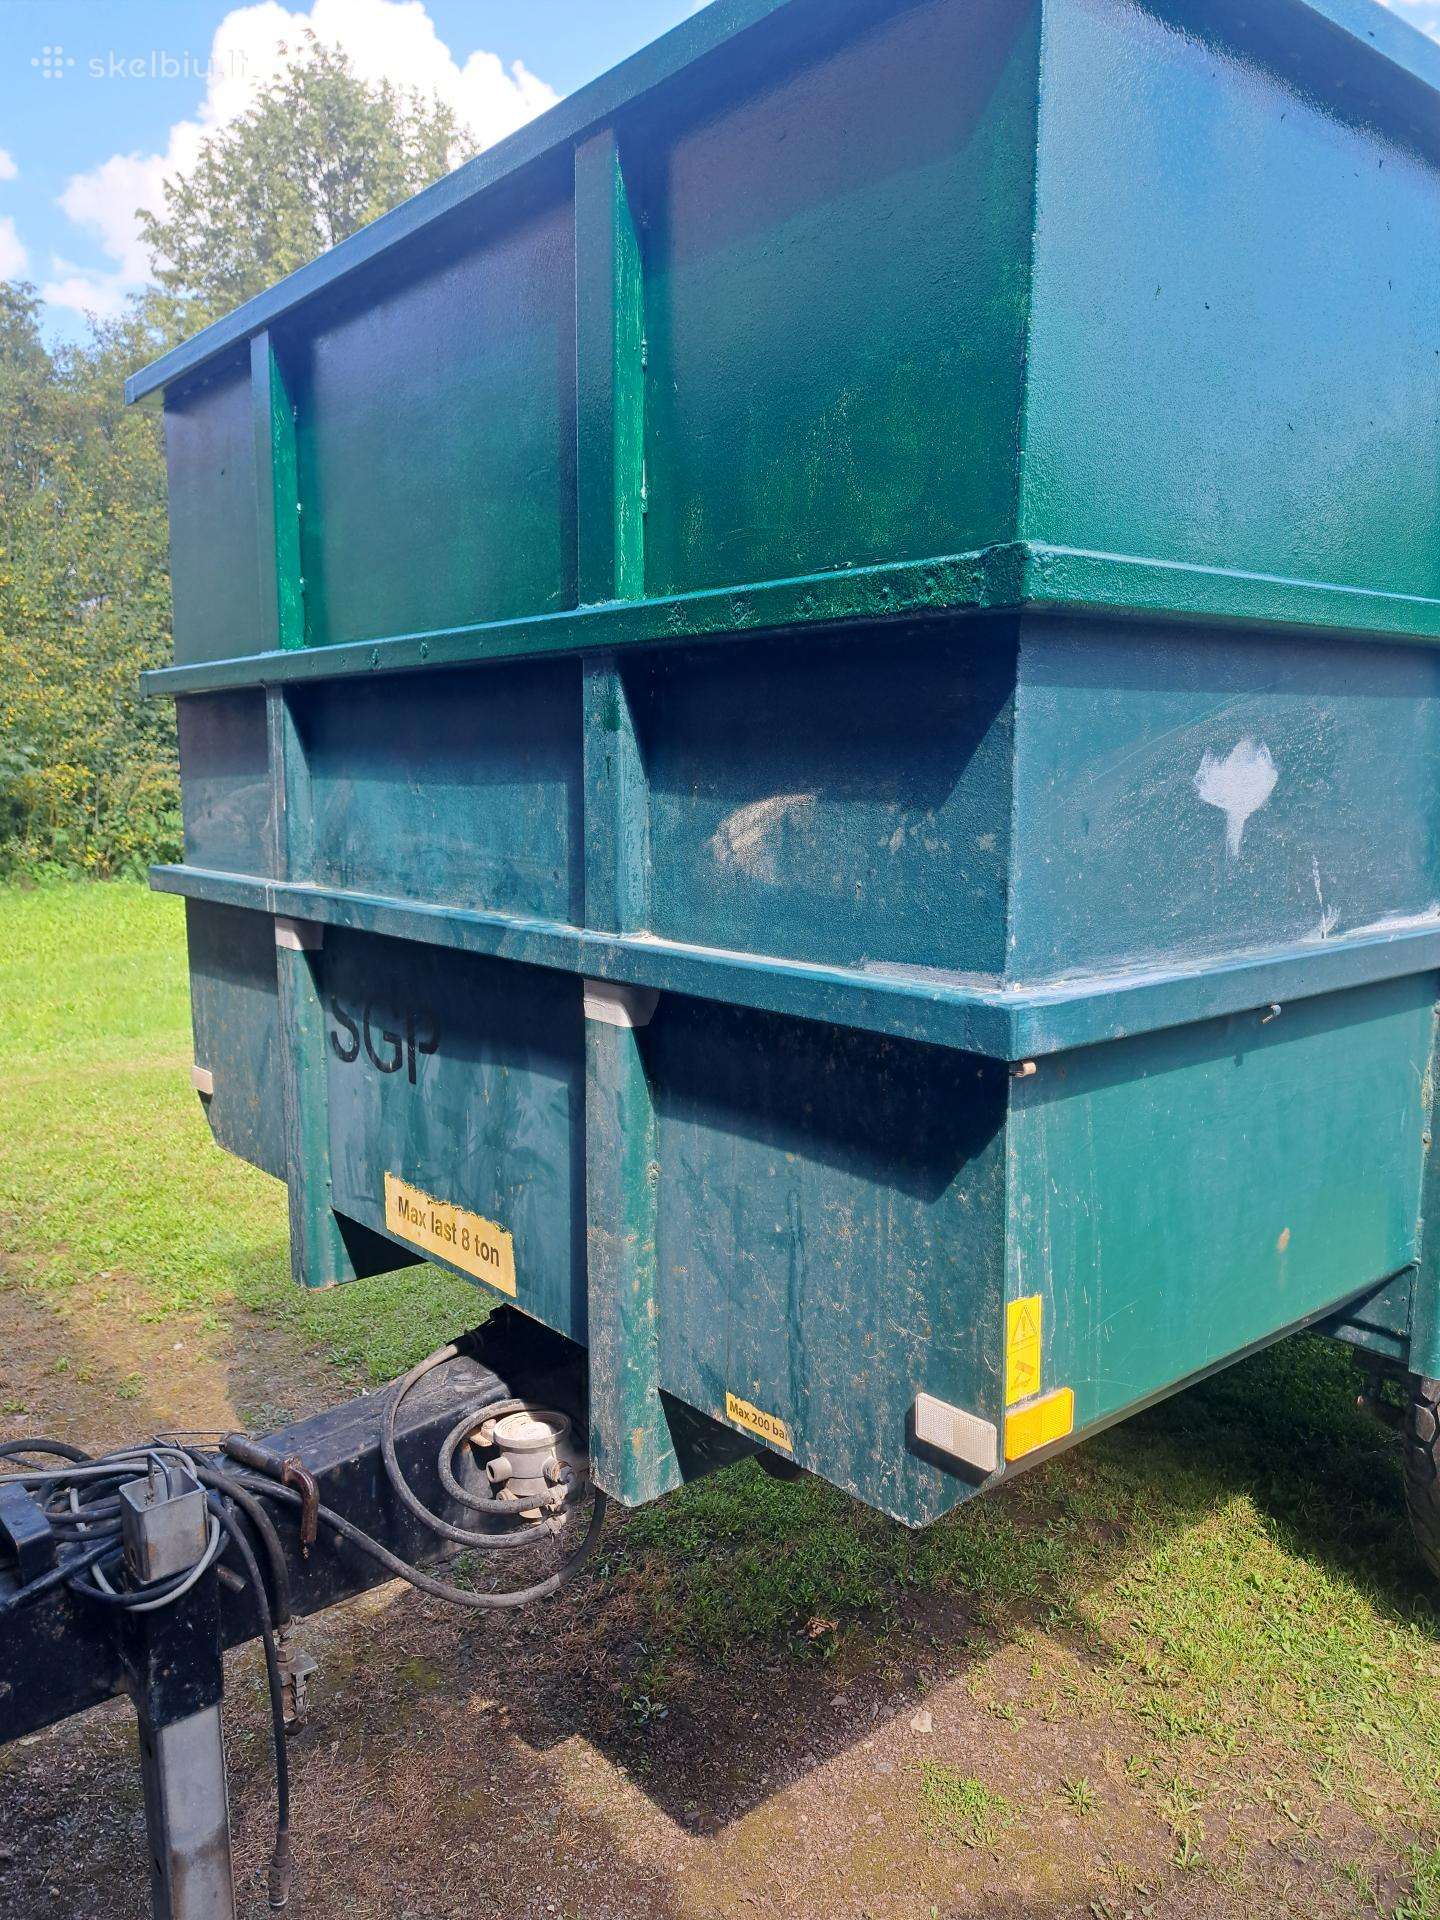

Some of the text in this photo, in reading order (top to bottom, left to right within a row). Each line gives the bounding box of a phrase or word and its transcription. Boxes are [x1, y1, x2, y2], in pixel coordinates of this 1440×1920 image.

[331, 994, 440, 1085] SGP
[398, 1195, 500, 1268] Max last 8 ton
[729, 1400, 750, 1421] Max
[751, 1413, 770, 1431] 200
